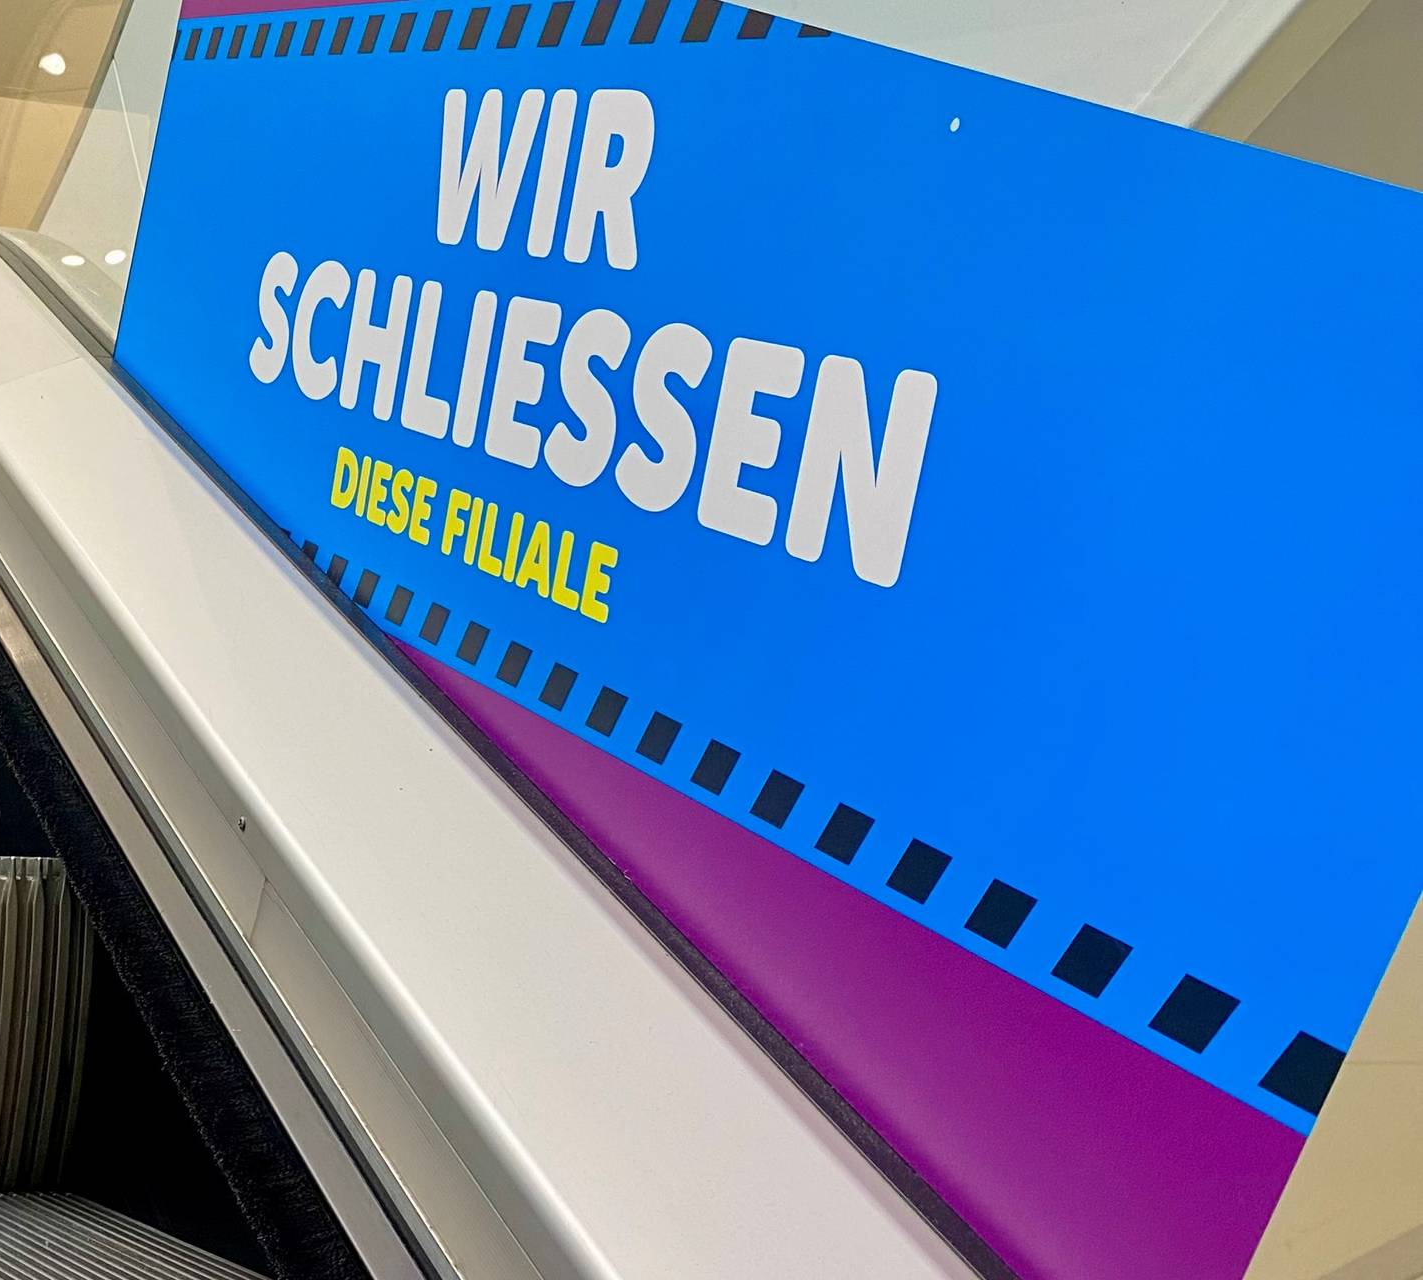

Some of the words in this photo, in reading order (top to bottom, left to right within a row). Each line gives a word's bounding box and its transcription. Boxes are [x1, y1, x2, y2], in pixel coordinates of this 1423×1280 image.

[436, 88, 655, 270] WIR
[249, 252, 938, 588] SCHLIESSEN
[331, 447, 437, 545] DIESE
[442, 489, 618, 623] FILIALE
